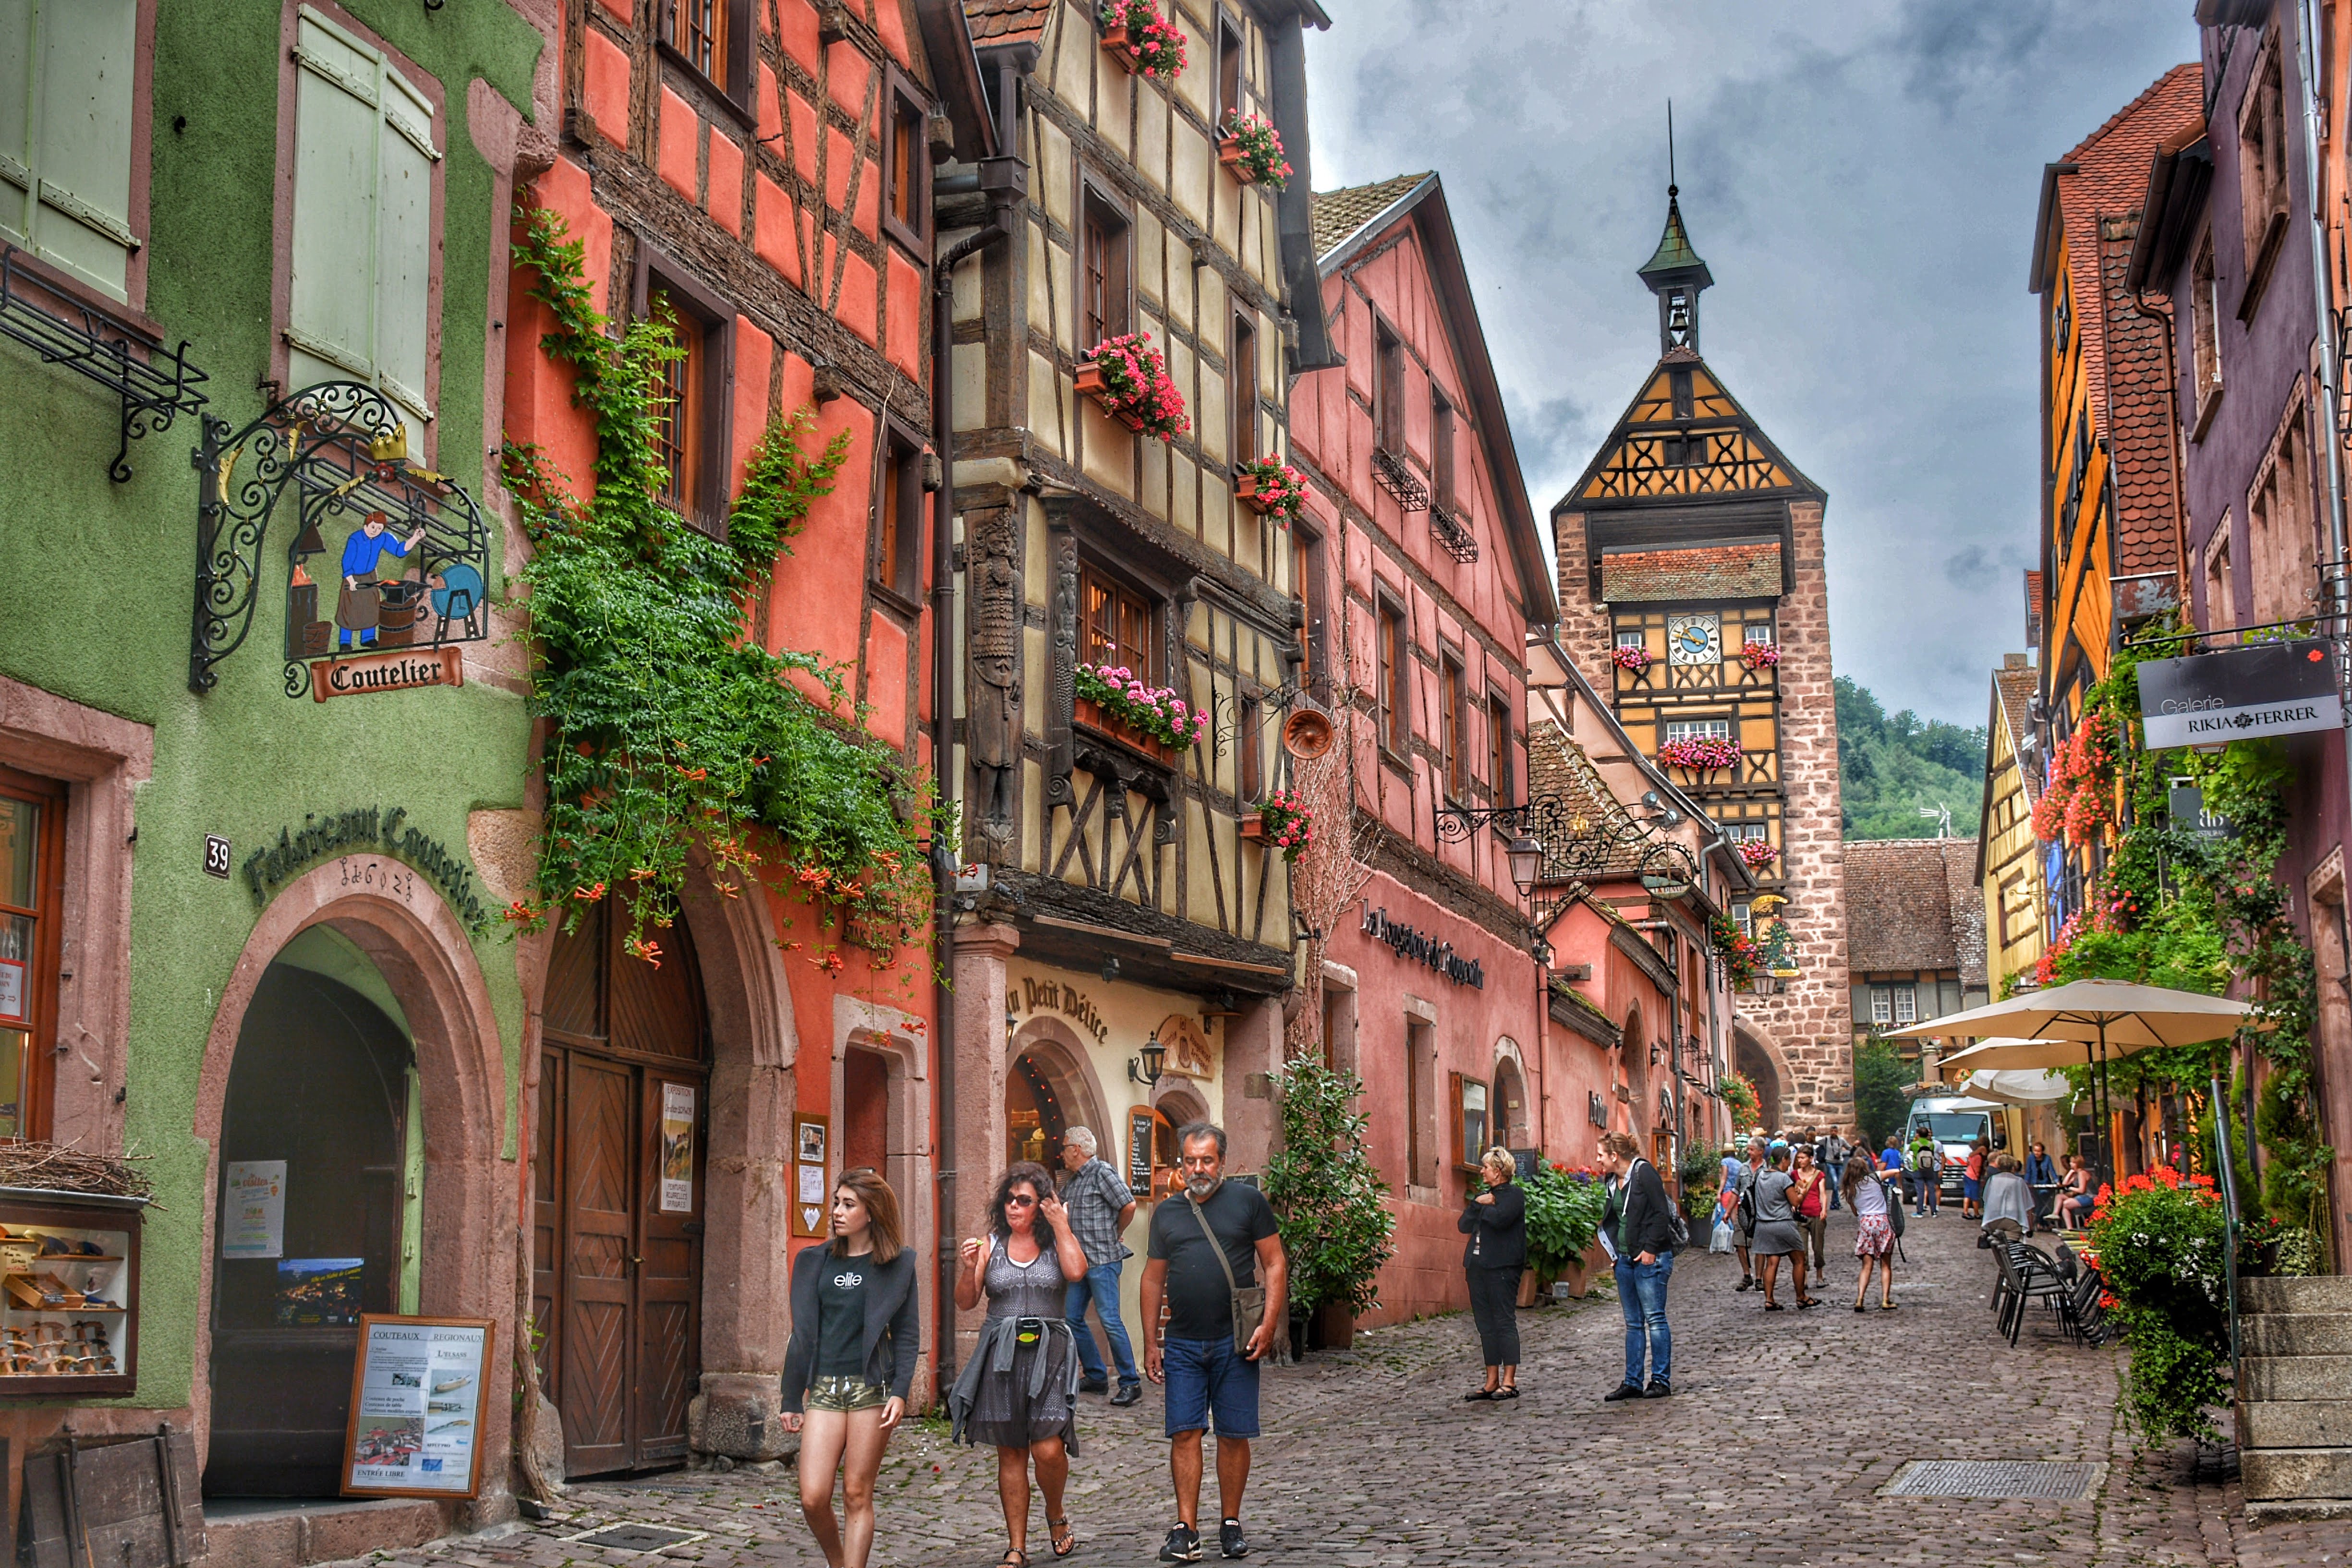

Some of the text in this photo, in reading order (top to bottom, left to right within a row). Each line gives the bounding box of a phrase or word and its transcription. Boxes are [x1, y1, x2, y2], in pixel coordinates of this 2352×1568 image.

[331, 659, 442, 690] Coutelier
[2160, 695, 2225, 715] Galerie
[2188, 706, 2319, 733] RIKIA FERRER
[208, 841, 229, 871] 39
[1022, 977, 1059, 1014] Petit
[1062, 982, 1108, 1044] Délice
[667, 1086, 691, 1097] EXPOSITION
[834, 1272, 862, 1287] elite
[374, 1331, 484, 1342] COUTEAUX REGIONAUX
[357, 1468, 384, 1476] ENTRÉE
